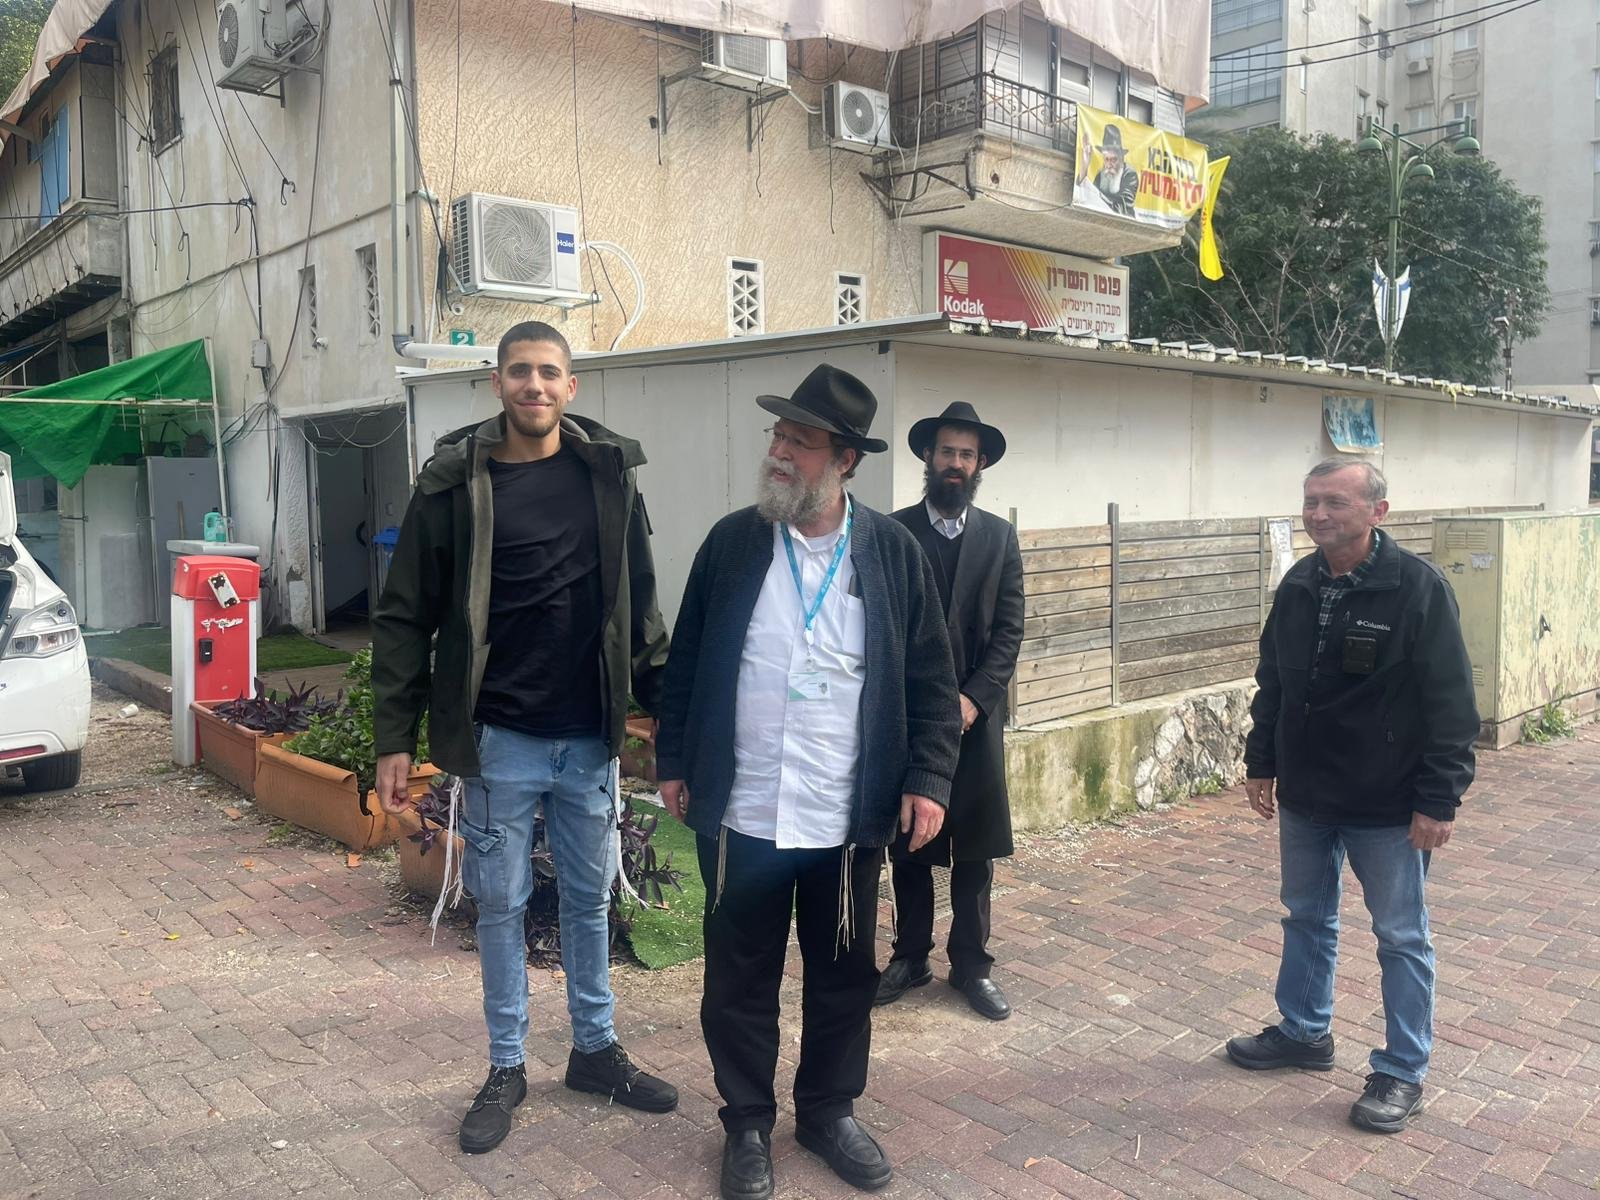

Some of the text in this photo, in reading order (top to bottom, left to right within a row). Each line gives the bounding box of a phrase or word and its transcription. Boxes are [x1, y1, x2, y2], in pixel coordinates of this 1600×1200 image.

[556, 239, 575, 248] Haier
[1046, 266, 1121, 296] פוטו השרון
[944, 295, 984, 315] Kodak
[1096, 303, 1121, 317] מעבדה
[1067, 317, 1115, 334] צילום ארועים
[457, 333, 469, 346] 2
[1362, 620, 1391, 631] Columbia
